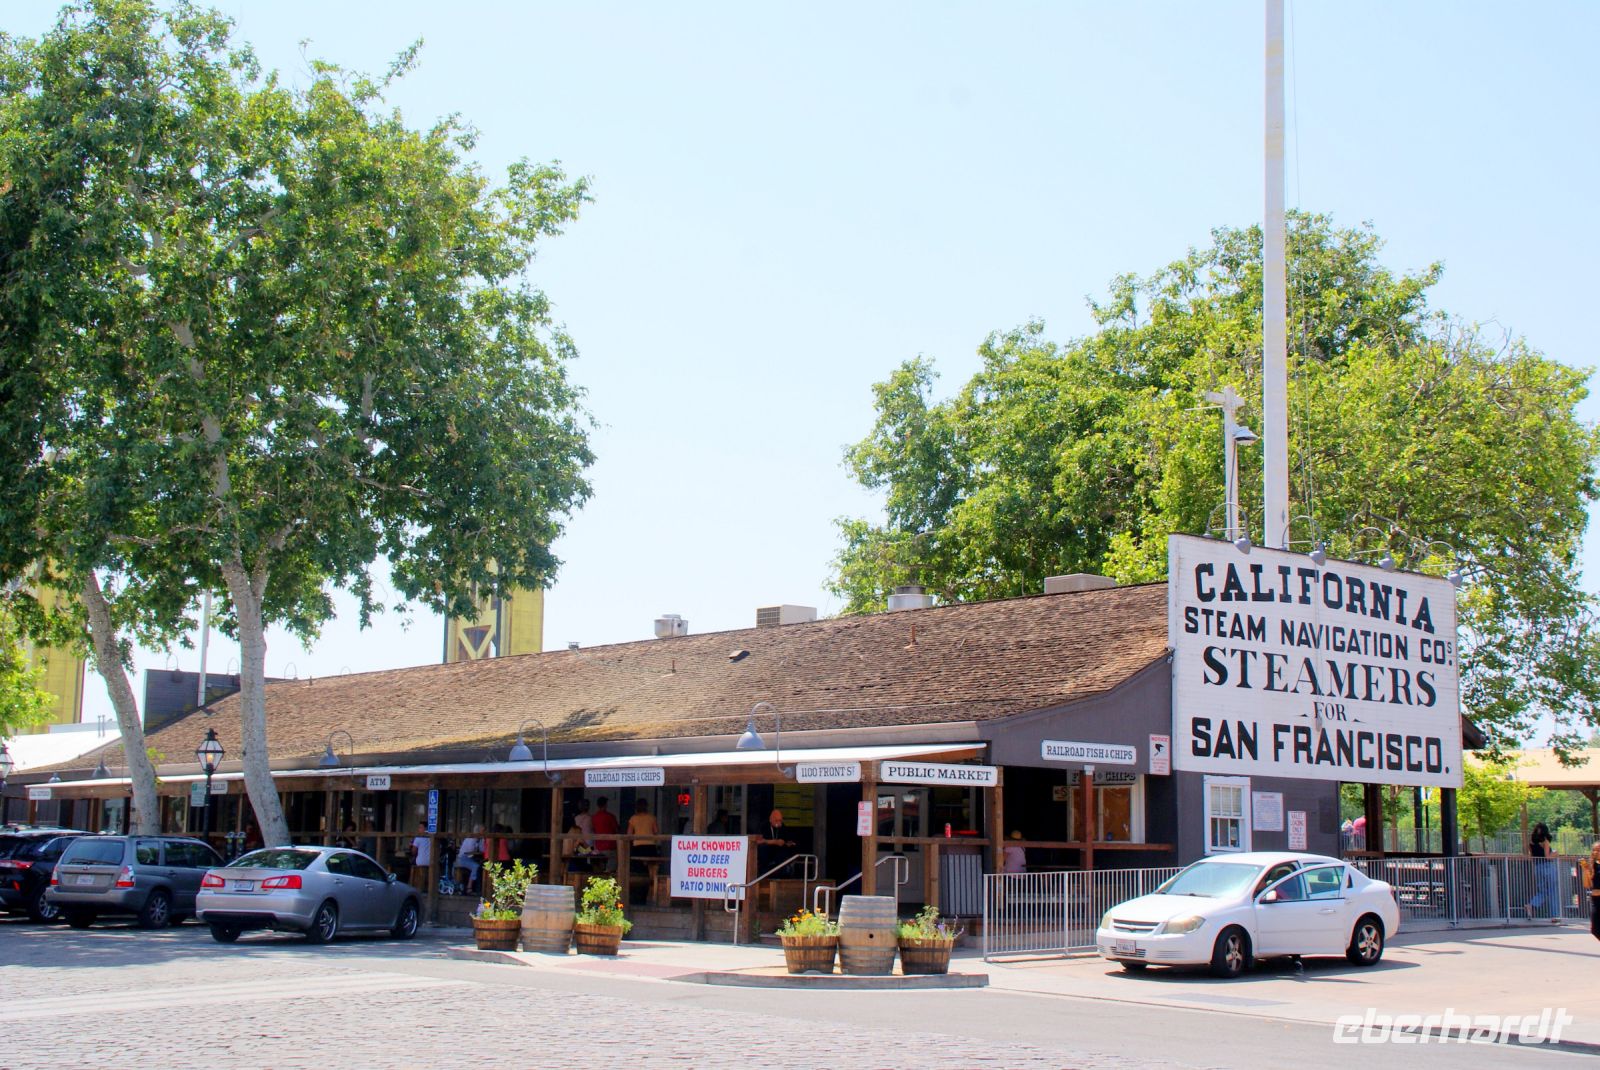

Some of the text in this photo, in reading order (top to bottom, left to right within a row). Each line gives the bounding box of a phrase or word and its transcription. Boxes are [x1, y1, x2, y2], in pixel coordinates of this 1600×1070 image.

[1195, 563, 1434, 634] CALIFORNIA
[1185, 606, 1266, 643] STEAM
[1281, 618, 1408, 661] NAVIGATION
[1203, 645, 1437, 708] STEAMERS
[1313, 701, 1347, 722] FOR
[1191, 716, 1258, 761] SAN
[1046, 745, 1085, 757] RAILROAD
[1086, 748, 1104, 759] FISH
[1109, 749, 1133, 760] CHIPS
[587, 772, 620, 783] RAILROAD
[621, 772, 636, 782] FISH
[640, 771, 661, 782] CHIPS
[801, 767, 818, 778] 1100
[818, 766, 846, 777] FRONT
[888, 766, 992, 781] PUBLIC MARKET
[1105, 771, 1136, 782] CHIPS
[369, 778, 386, 786] ATM
[677, 840, 741, 851] CLAM CHOWDER
[687, 854, 730, 865] COLD BEER
[687, 867, 728, 878] BURGERS
[680, 881, 704, 892] PATIO
